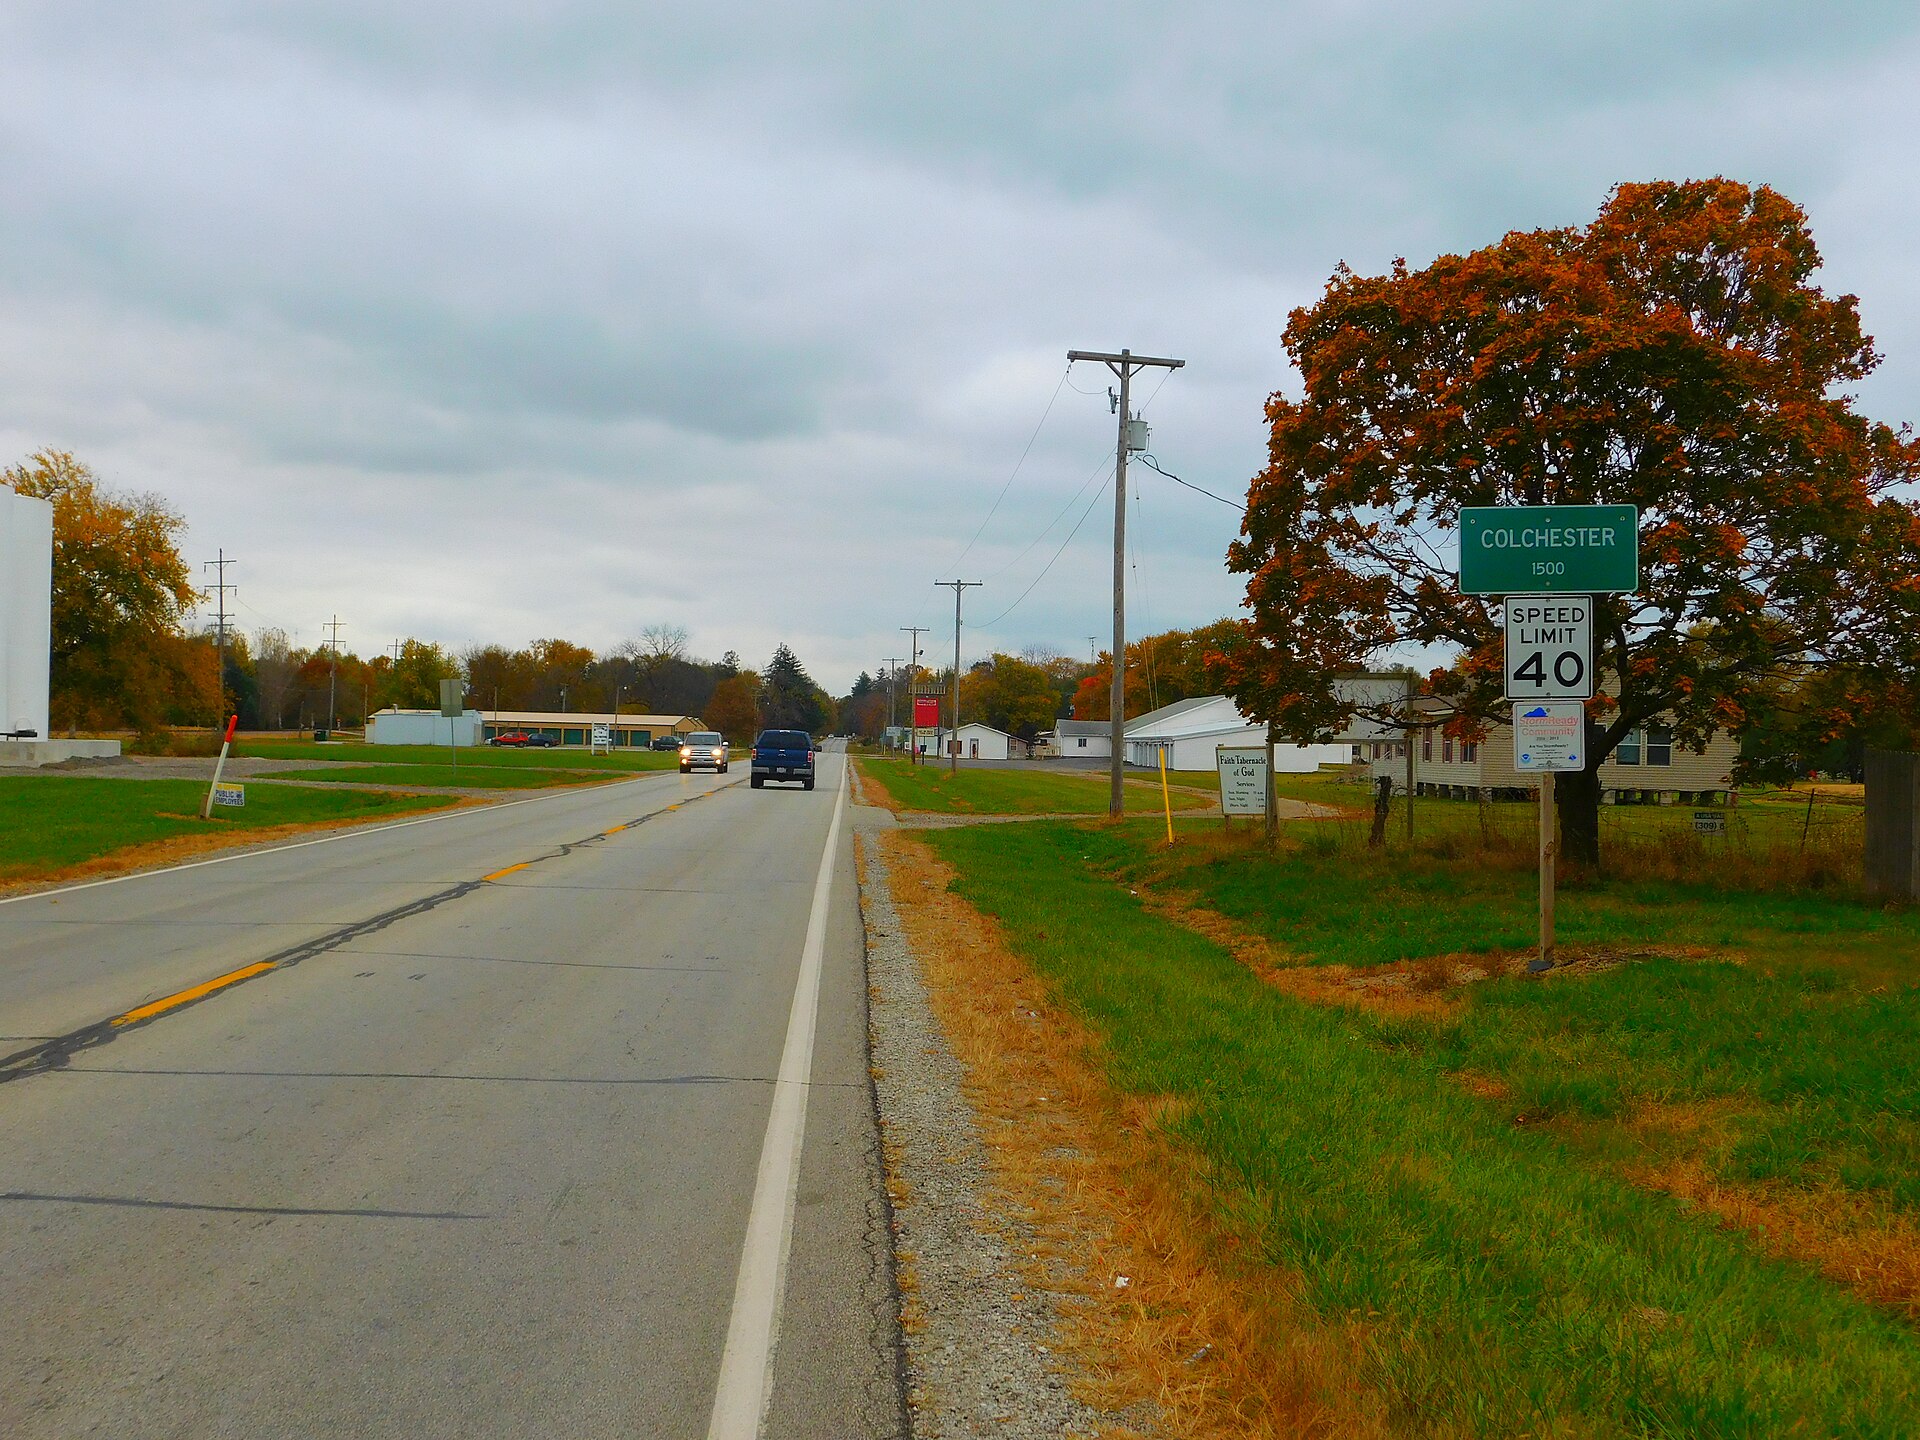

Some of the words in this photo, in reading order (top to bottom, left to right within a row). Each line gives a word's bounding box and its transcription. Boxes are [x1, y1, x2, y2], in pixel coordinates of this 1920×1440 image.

[1481, 527, 1615, 548] COLCHESTER
[1531, 562, 1565, 576] 1500
[1512, 607, 1585, 624] SPEED
[1520, 627, 1577, 644] LIMIT
[1513, 650, 1585, 688] 40
[1519, 716, 1578, 726] StormReady
[1522, 728, 1575, 736] Community
[1220, 755, 1235, 764] Faith
[1235, 755, 1266, 764] Tabernacle
[1241, 766, 1254, 776] God
[216, 790, 234, 798] PUBLIC
[216, 797, 243, 805] EMPLOYEES
